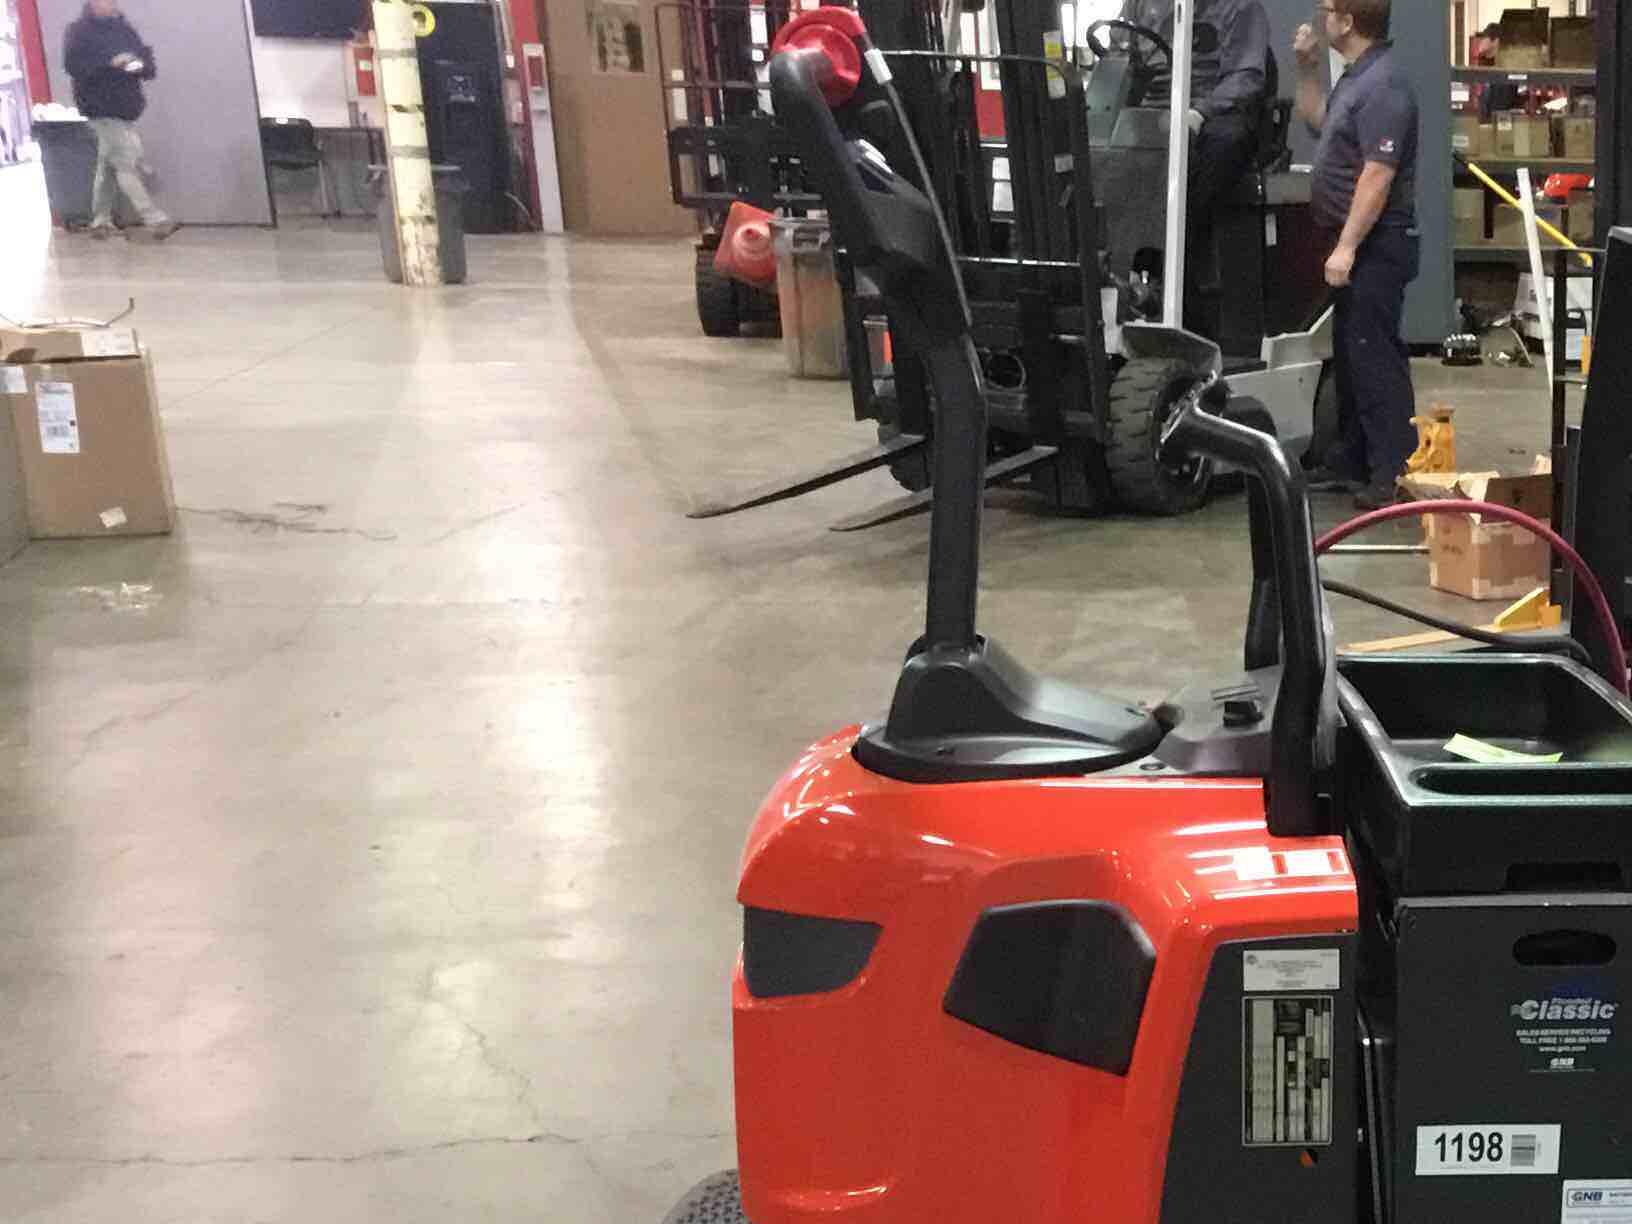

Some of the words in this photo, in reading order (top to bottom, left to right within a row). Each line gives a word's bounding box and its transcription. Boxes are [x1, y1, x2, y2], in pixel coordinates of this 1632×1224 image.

[1520, 1000, 1616, 1020] Classic
[1434, 1131, 1504, 1162] 1198
[1571, 1191, 1603, 1201] GNB
